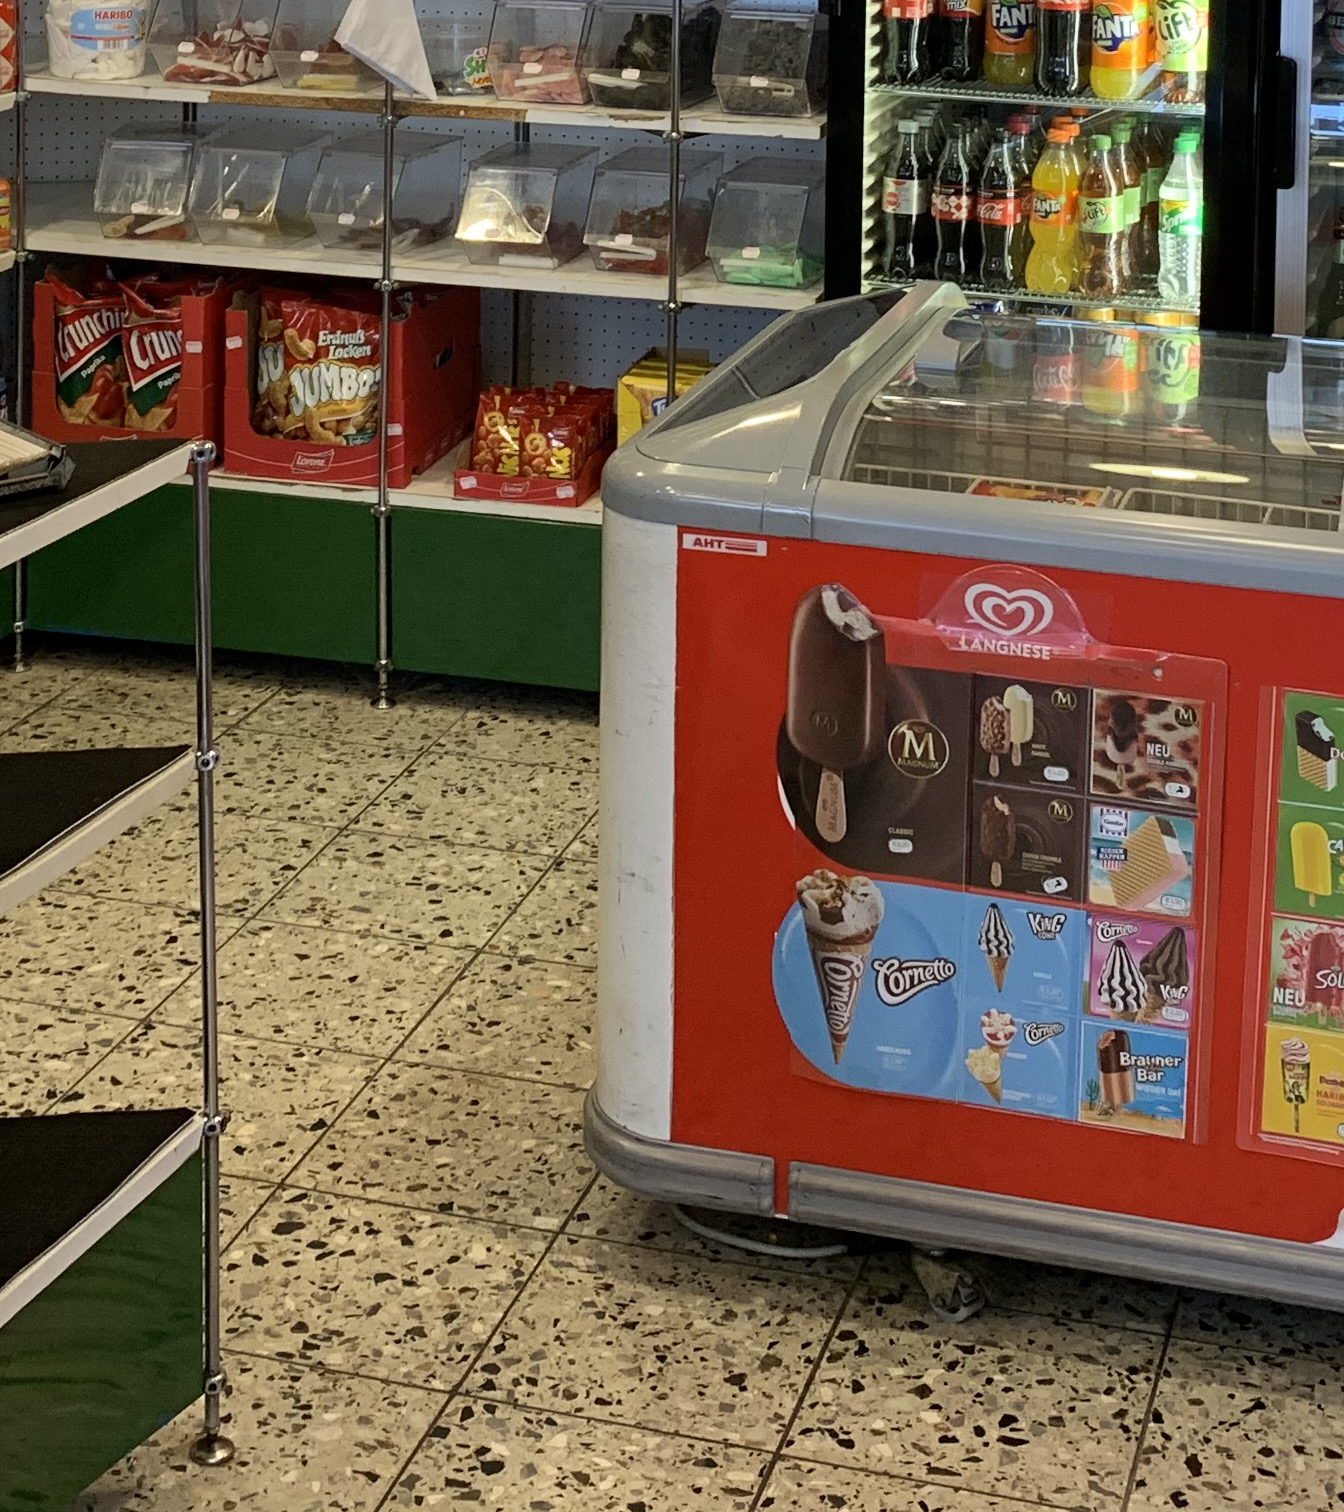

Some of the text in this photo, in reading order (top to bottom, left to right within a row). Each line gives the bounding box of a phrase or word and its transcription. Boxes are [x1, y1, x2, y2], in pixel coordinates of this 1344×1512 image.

[94, 9, 134, 21] HARIBO
[317, 328, 365, 346] Erdnuß
[328, 343, 372, 360] Locken
[80, 353, 106, 378] Paprika
[692, 537, 725, 551] AHT
[959, 635, 1052, 660] LANGNESE
[1146, 743, 1172, 759] NEU
[1027, 912, 1067, 933] KING
[870, 957, 956, 1007] Cornetto
[1160, 983, 1189, 1001] KING
[1272, 987, 1306, 1007] NEU
[1118, 1052, 1182, 1068] Brauner
[1136, 1067, 1165, 1083] Bar
